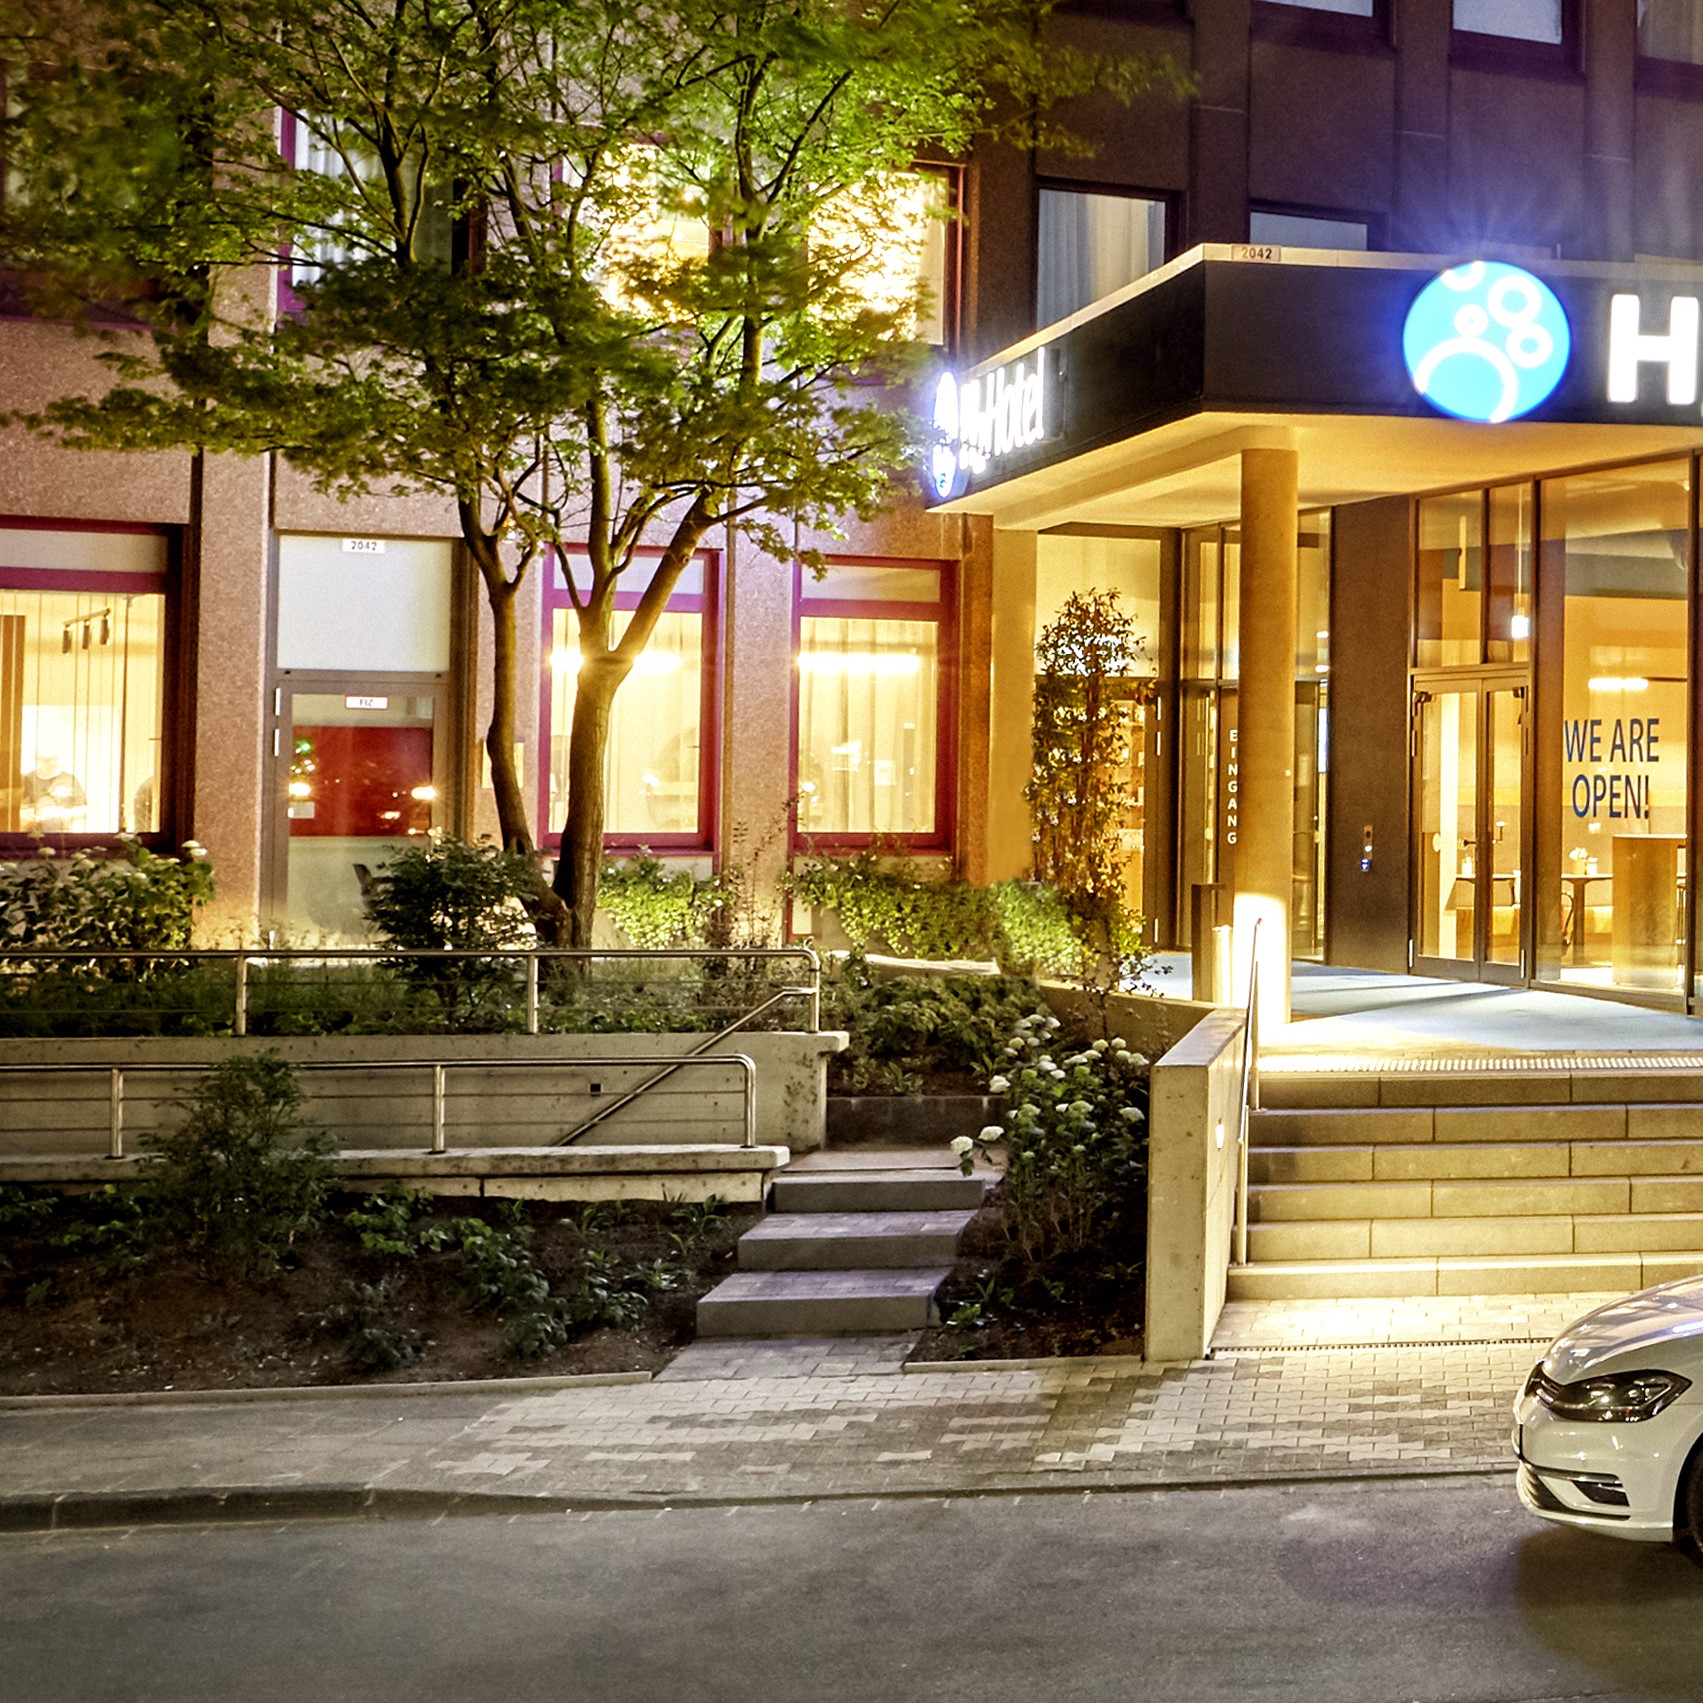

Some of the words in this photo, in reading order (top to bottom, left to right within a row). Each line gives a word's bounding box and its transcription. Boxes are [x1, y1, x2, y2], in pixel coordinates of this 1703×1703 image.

[1241, 247, 1272, 259] 2042
[350, 540, 377, 551] 2042
[1564, 719, 1602, 762] WE
[1609, 718, 1659, 762] ARE
[1227, 729, 1238, 844] EINGANG
[1572, 774, 1649, 819] OPEN!
